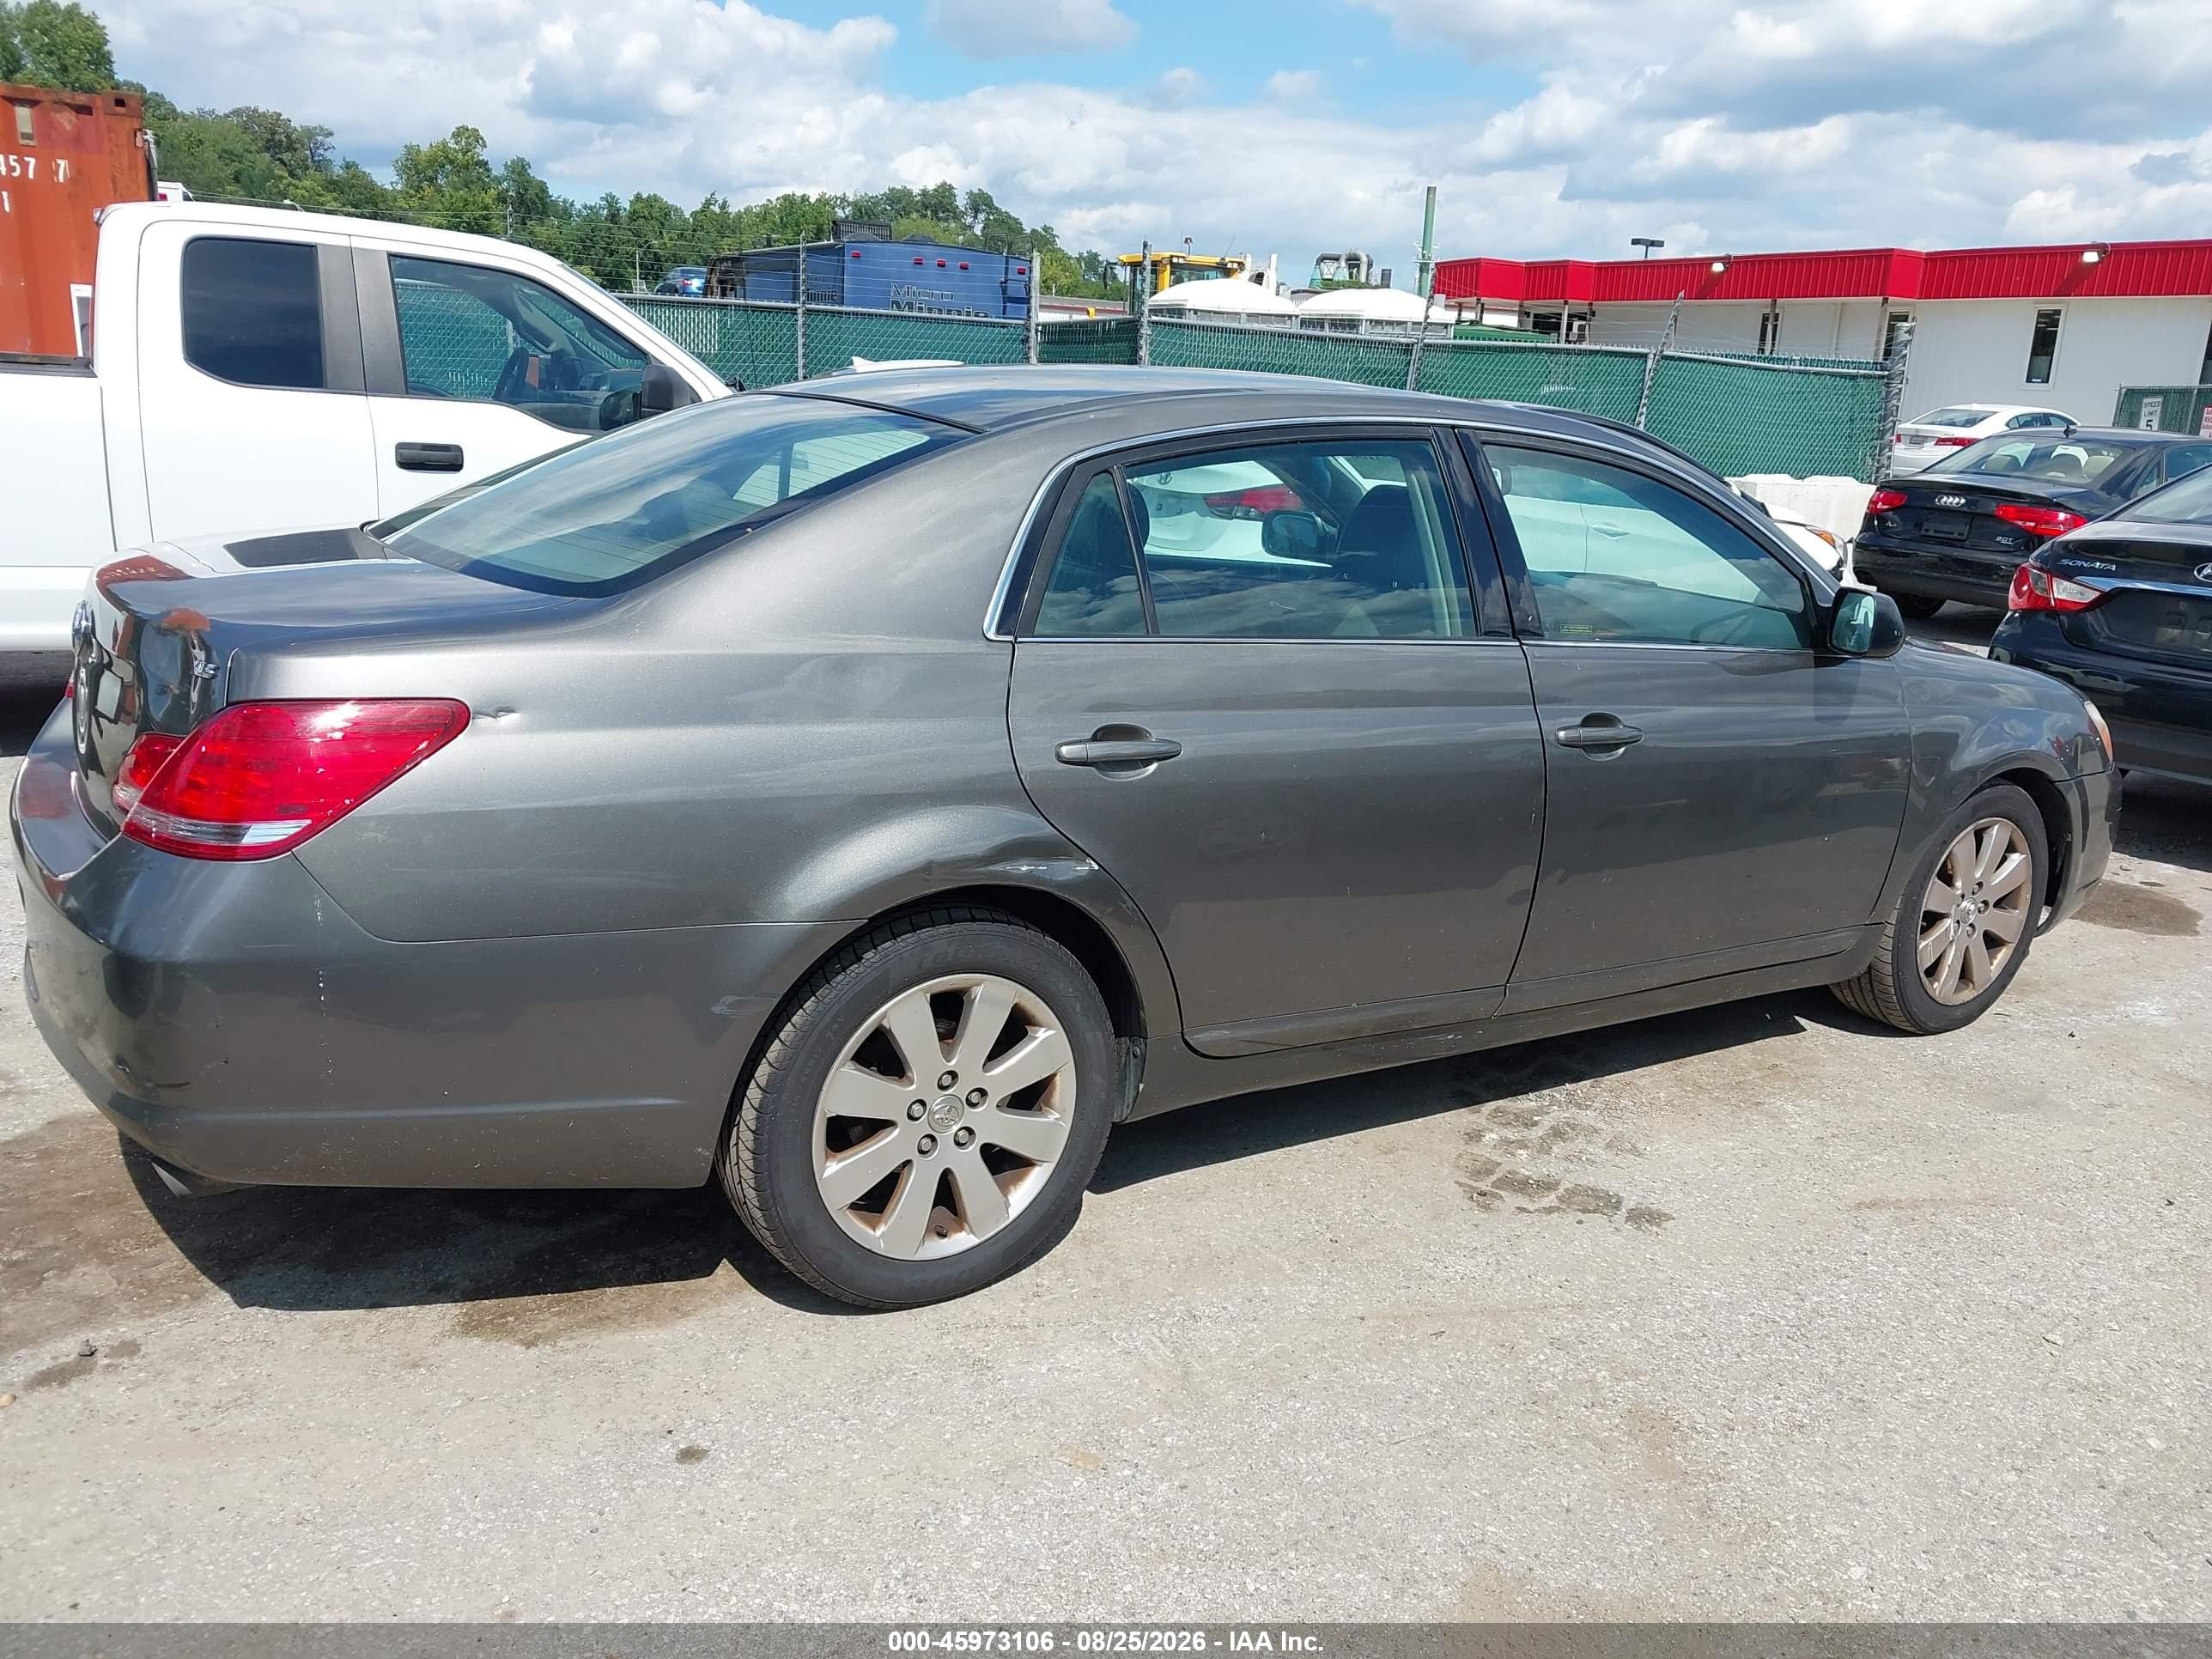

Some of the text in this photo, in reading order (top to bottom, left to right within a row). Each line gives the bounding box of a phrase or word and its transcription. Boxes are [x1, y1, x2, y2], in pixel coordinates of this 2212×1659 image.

[805, 287, 837, 301] innie
[890, 283, 954, 301] Micro
[2146, 419, 2154, 430] 5
[2057, 558, 2117, 571] SONATA
